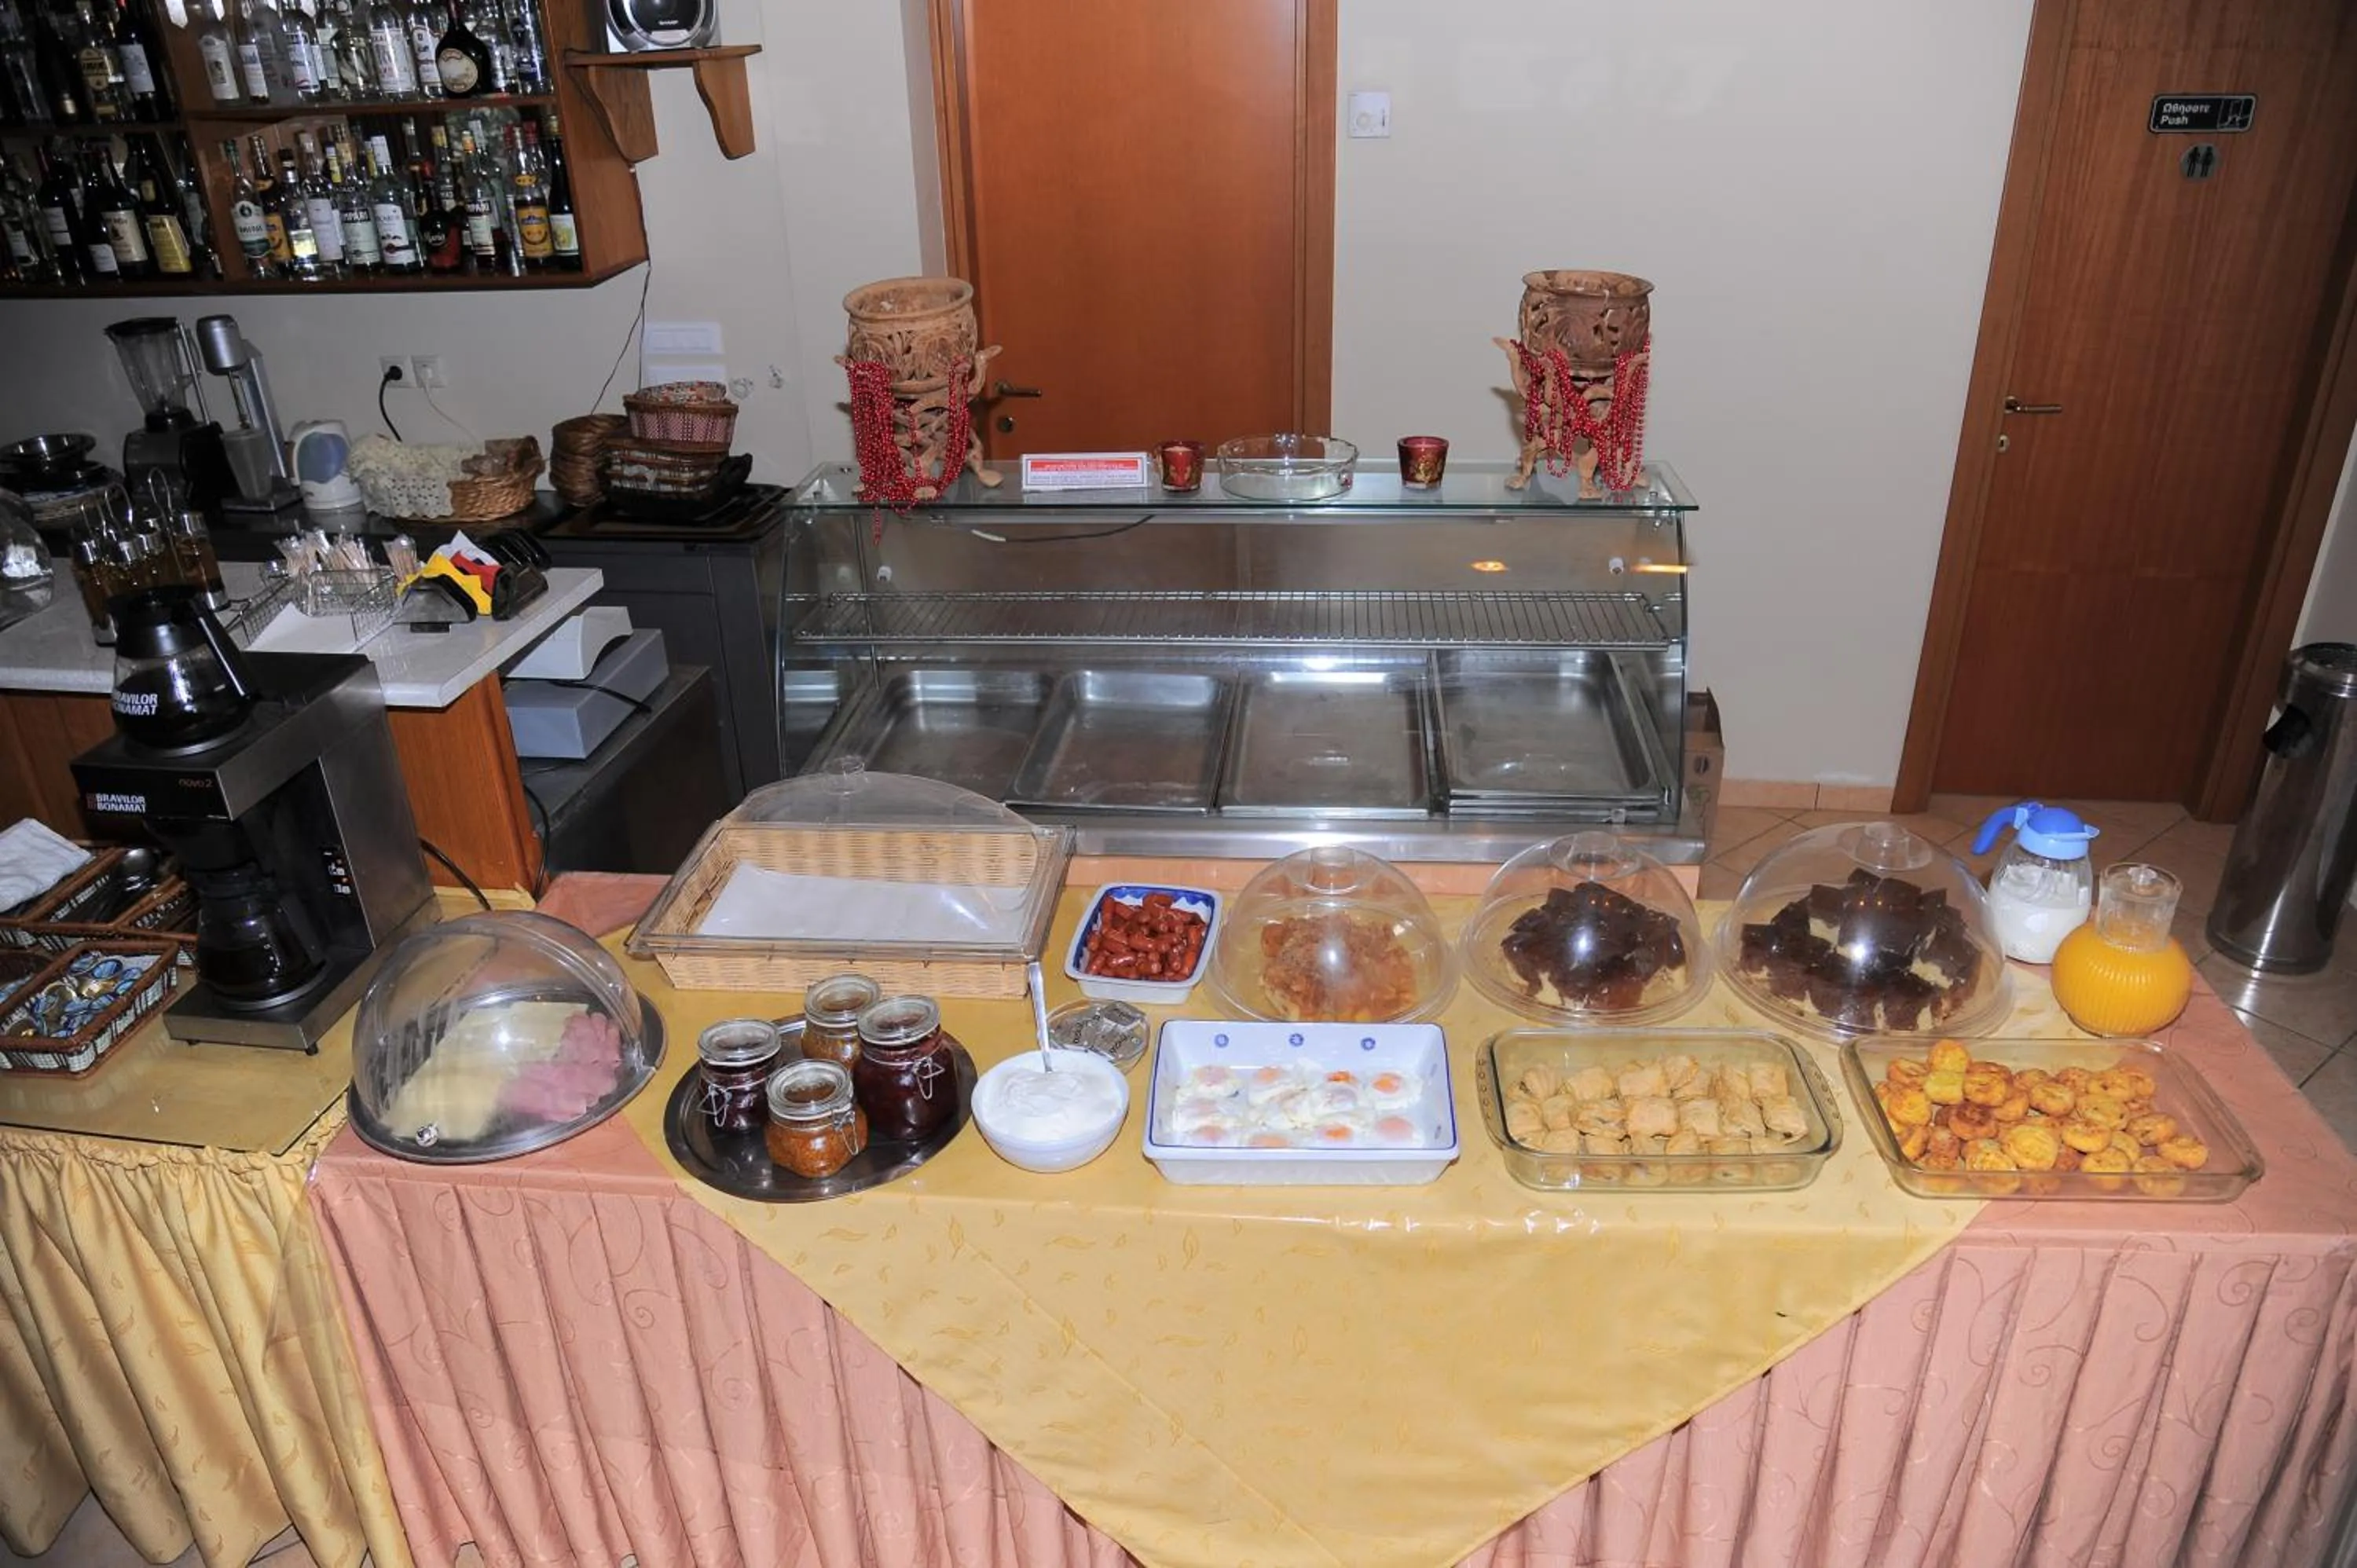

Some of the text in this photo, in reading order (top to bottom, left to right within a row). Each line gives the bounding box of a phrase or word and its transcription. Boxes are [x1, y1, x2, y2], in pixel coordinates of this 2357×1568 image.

[2160, 115, 2188, 126] Push
[95, 793, 146, 804] BRAVILOR
[97, 802, 147, 814] BONAMAT
